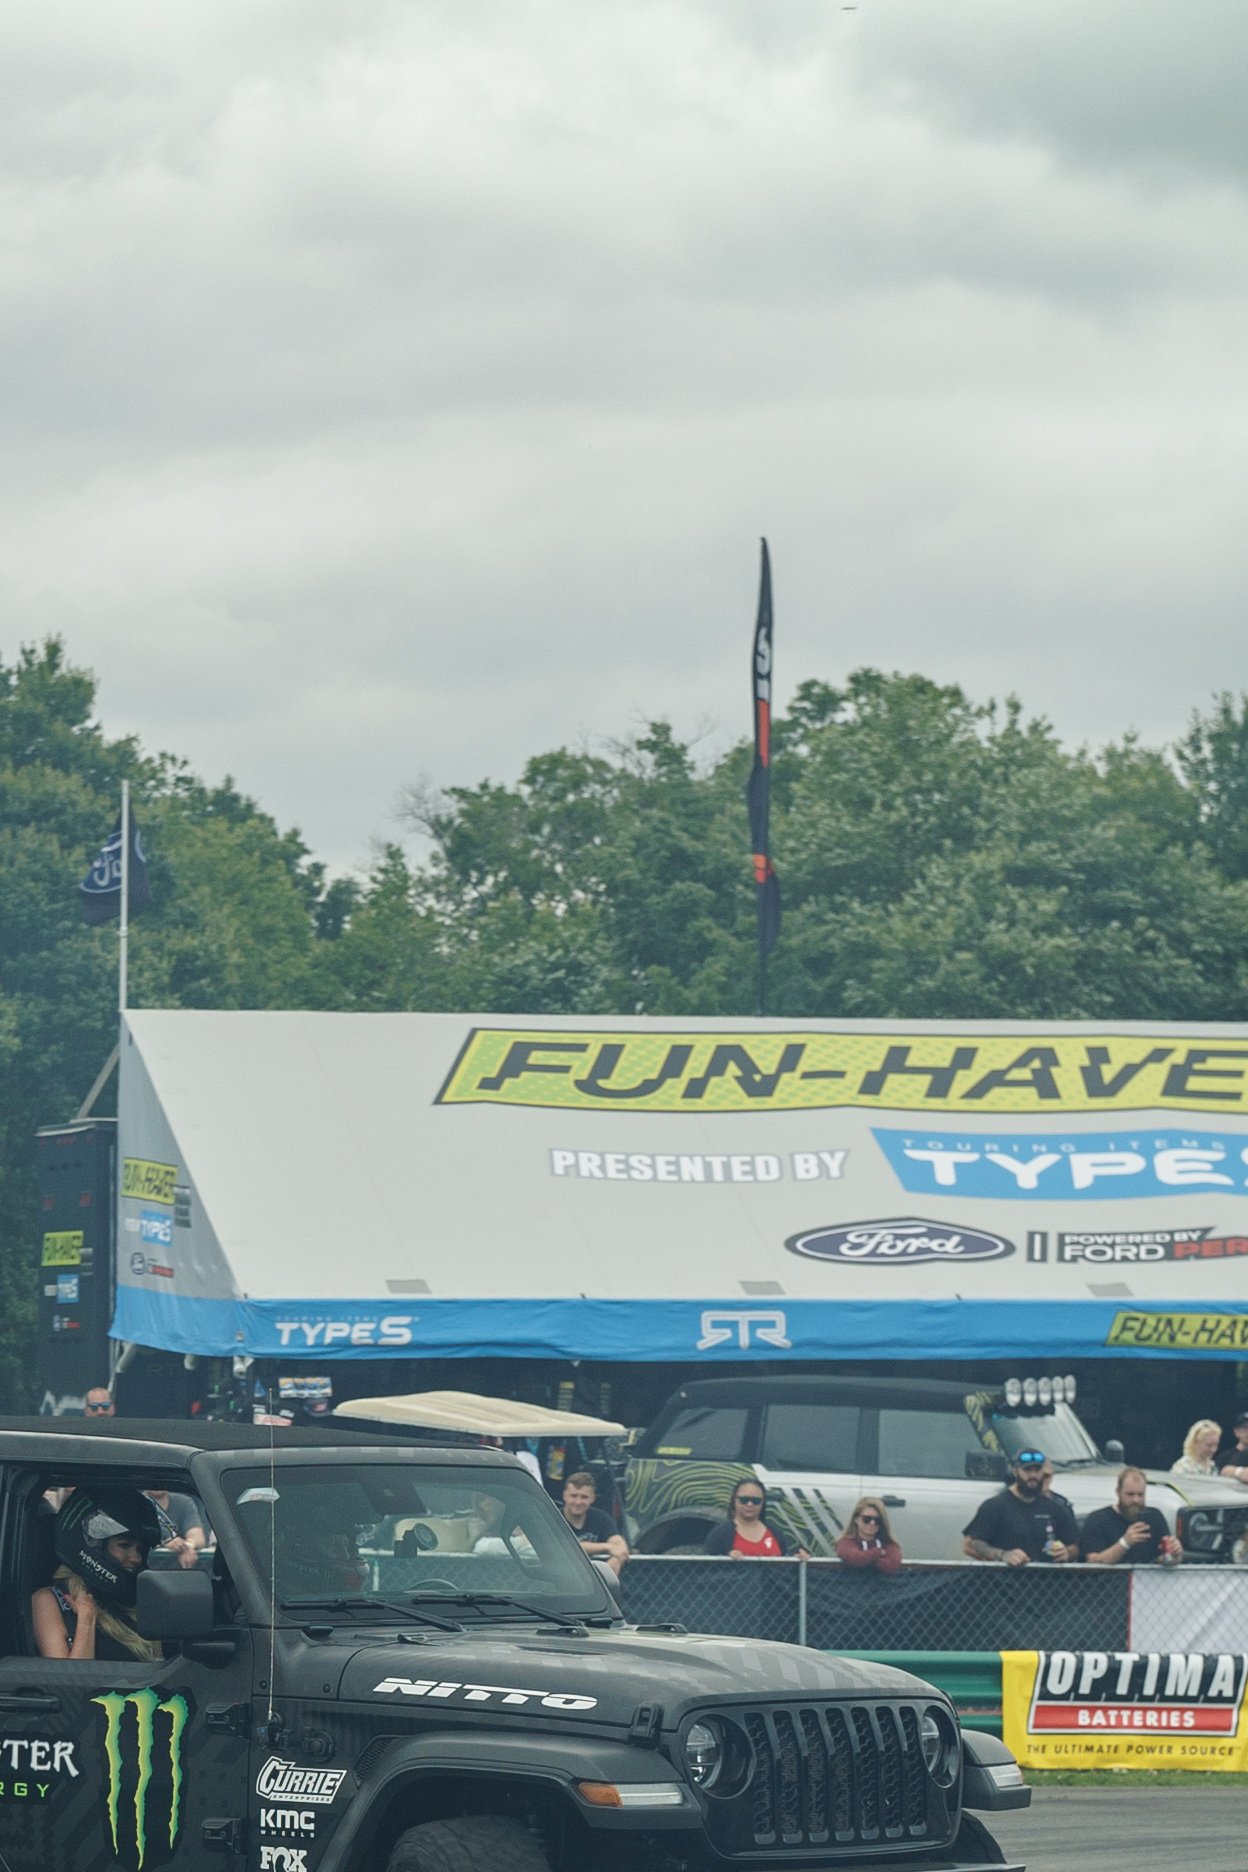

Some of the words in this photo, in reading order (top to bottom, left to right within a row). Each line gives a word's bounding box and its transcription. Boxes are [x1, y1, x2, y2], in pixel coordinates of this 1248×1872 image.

[903, 1138, 1076, 1154] TOURING
[1108, 1138, 1225, 1151] ITEMS
[552, 1149, 780, 1182] PRESENTED
[793, 1150, 846, 1180] BY
[903, 1148, 1248, 1190] TYPE
[839, 1226, 965, 1256] Ford
[1063, 1231, 1172, 1246] POWERED
[1173, 1230, 1202, 1242] BY
[1063, 1244, 1166, 1261] FORD
[1046, 1651, 1237, 1697] OPTIMA
[373, 1677, 598, 1710] NITTO
[1077, 1709, 1196, 1728] BATTERIES
[1026, 1743, 1047, 1755] THE
[1053, 1743, 1120, 1755] ULTIMATE
[1125, 1744, 1174, 1756] POWER
[259, 1760, 342, 1795] CURRIE
[260, 1829, 315, 1838] WHEELS
